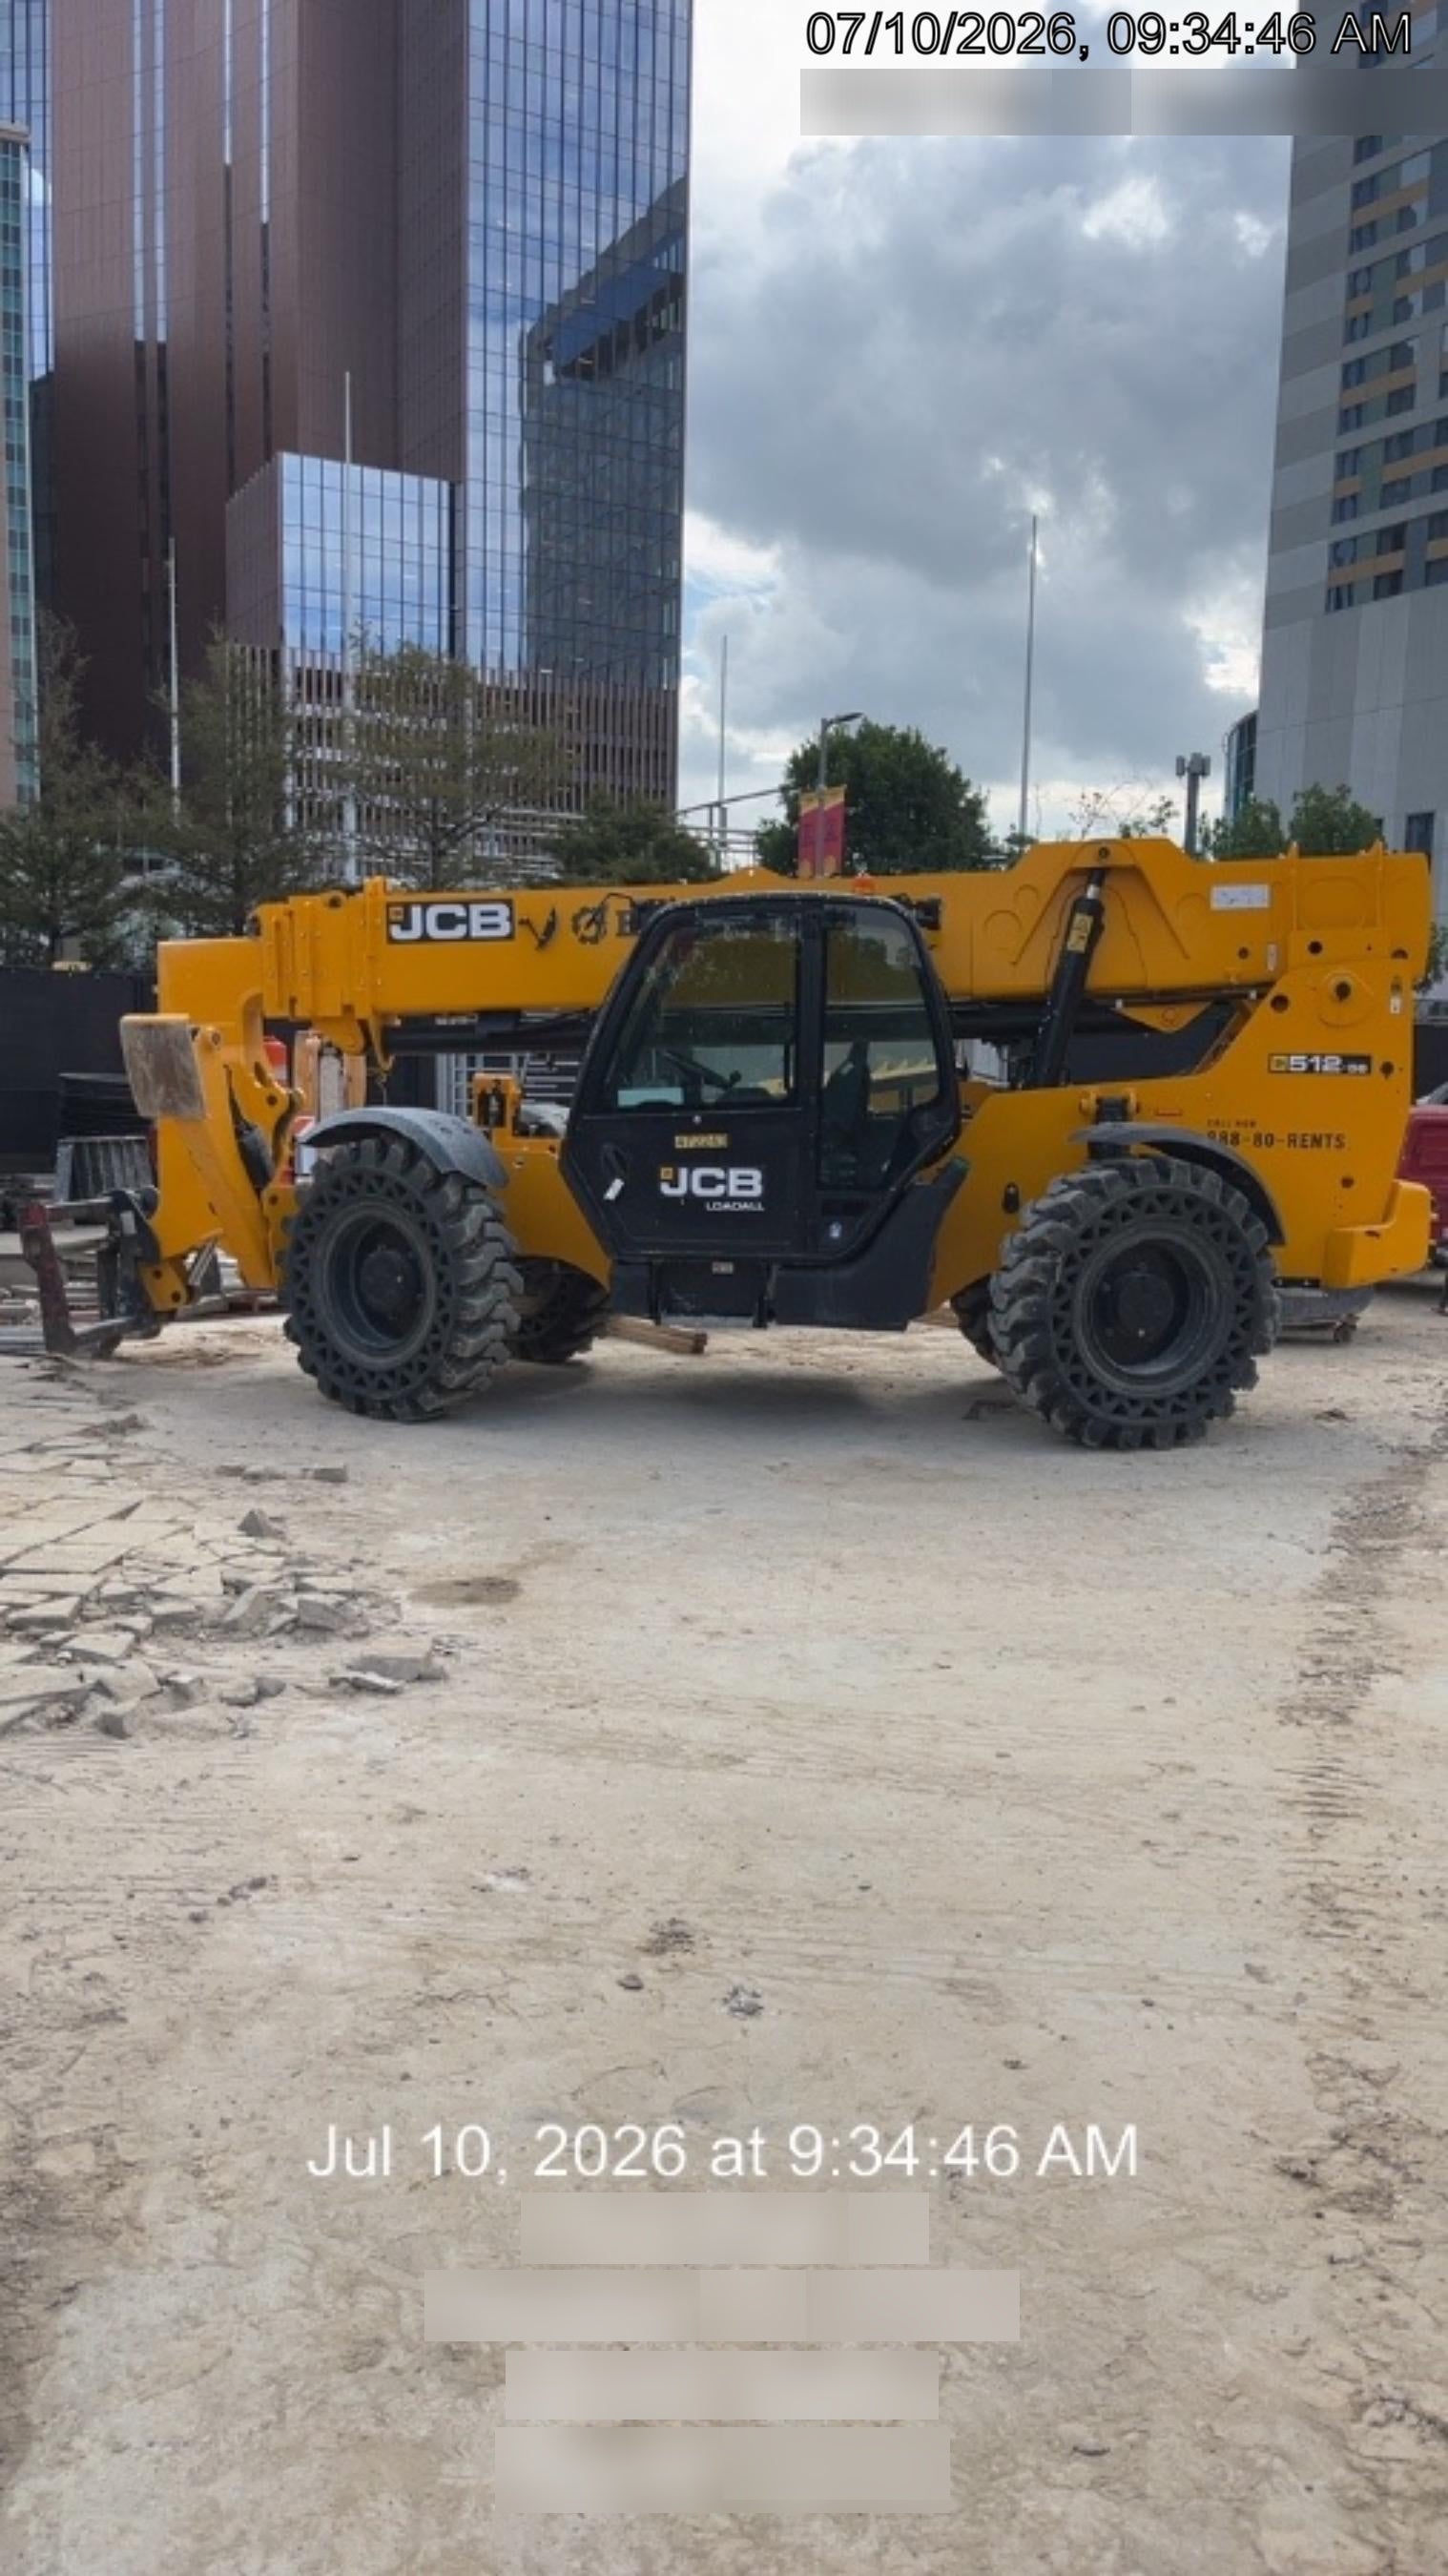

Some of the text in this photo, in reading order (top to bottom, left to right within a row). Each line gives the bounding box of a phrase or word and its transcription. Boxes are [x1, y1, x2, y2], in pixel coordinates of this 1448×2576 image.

[389, 904, 512, 941] JCB
[659, 1167, 763, 1197] JCB
[706, 1201, 765, 1212] LOADALL
